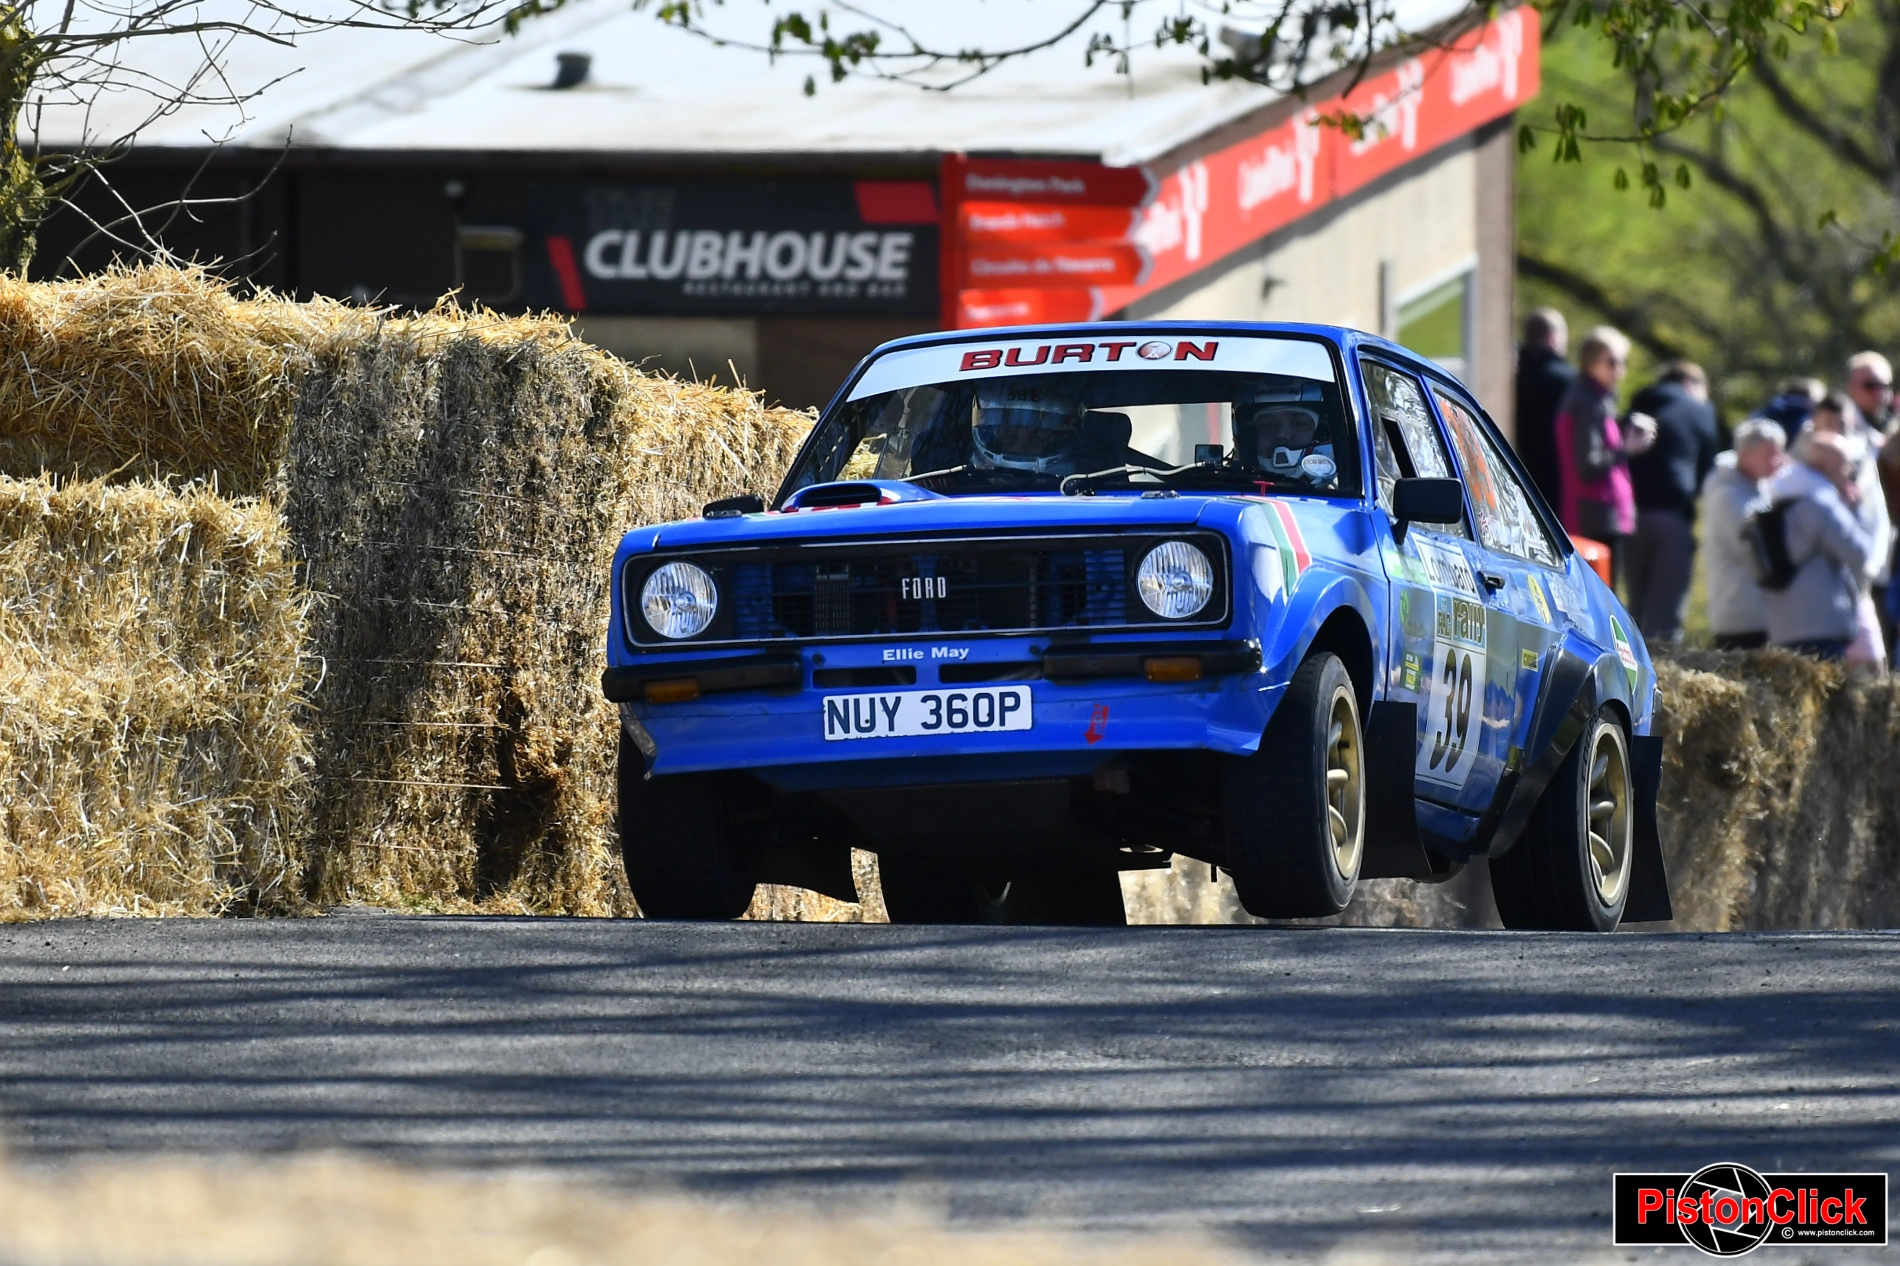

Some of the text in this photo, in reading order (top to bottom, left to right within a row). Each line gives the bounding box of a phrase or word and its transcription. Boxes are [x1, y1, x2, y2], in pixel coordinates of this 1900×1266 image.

[585, 230, 913, 280] CLUBHOUSE
[959, 340, 1219, 372] BURTON
[901, 575, 947, 600] FORD
[1453, 598, 1485, 646] rally
[882, 645, 970, 663] Ellie May
[827, 690, 1021, 736] NUY 360P
[1430, 648, 1471, 773] 39
